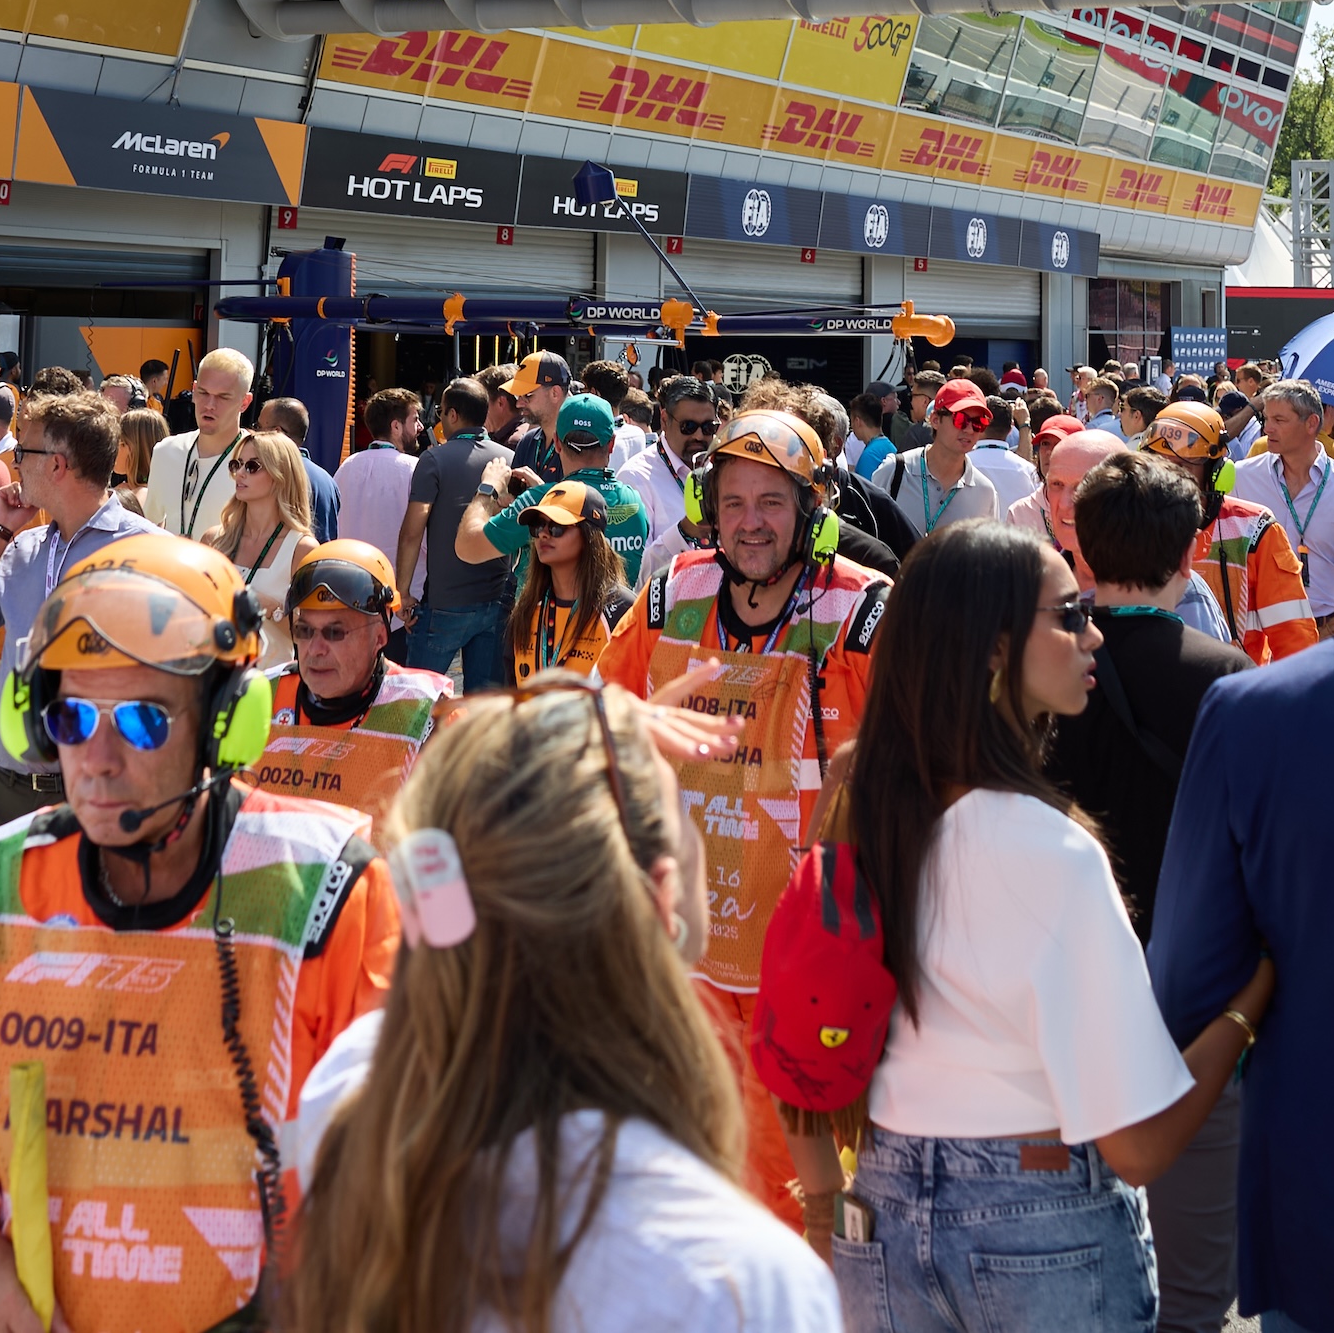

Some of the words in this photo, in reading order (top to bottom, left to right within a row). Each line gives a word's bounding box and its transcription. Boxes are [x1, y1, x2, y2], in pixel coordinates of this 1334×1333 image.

[360, 30, 509, 95] DHL
[598, 66, 710, 128] DHL
[776, 101, 864, 155] DHL
[111, 130, 217, 161] McLaren
[912, 127, 984, 175] DHL
[132, 164, 178, 178] FORMULA
[181, 169, 186, 178] 1
[190, 170, 215, 181] TEAM
[426, 160, 455, 176] PIRELLI
[1024, 150, 1082, 192] DHL
[347, 174, 411, 201] HOT
[413, 180, 484, 209] LAPS
[1115, 168, 1164, 205] DHL
[1190, 183, 1233, 216] DHL
[283, 209, 293, 225] 9
[501, 228, 509, 242] 8
[671, 238, 679, 249] 7
[804, 250, 812, 260] 6
[917, 259, 924, 269] 5
[586, 306, 606, 319] DP
[608, 306, 662, 321] WORLD
[827, 319, 844, 330] DP
[845, 319, 892, 330] WORLD
[316, 370, 326, 378] DP
[326, 370, 345, 379] WORLD
[573, 418, 592, 427] BOSS
[600, 483, 616, 491] BOSS
[650, 577, 662, 623] sparco
[858, 600, 885, 647] sparco
[259, 766, 342, 791] 0020-ITA
[4, 1095, 190, 1145] ARSHAL
[63, 1199, 150, 1242] ALL
[63, 1238, 183, 1284] TIME
